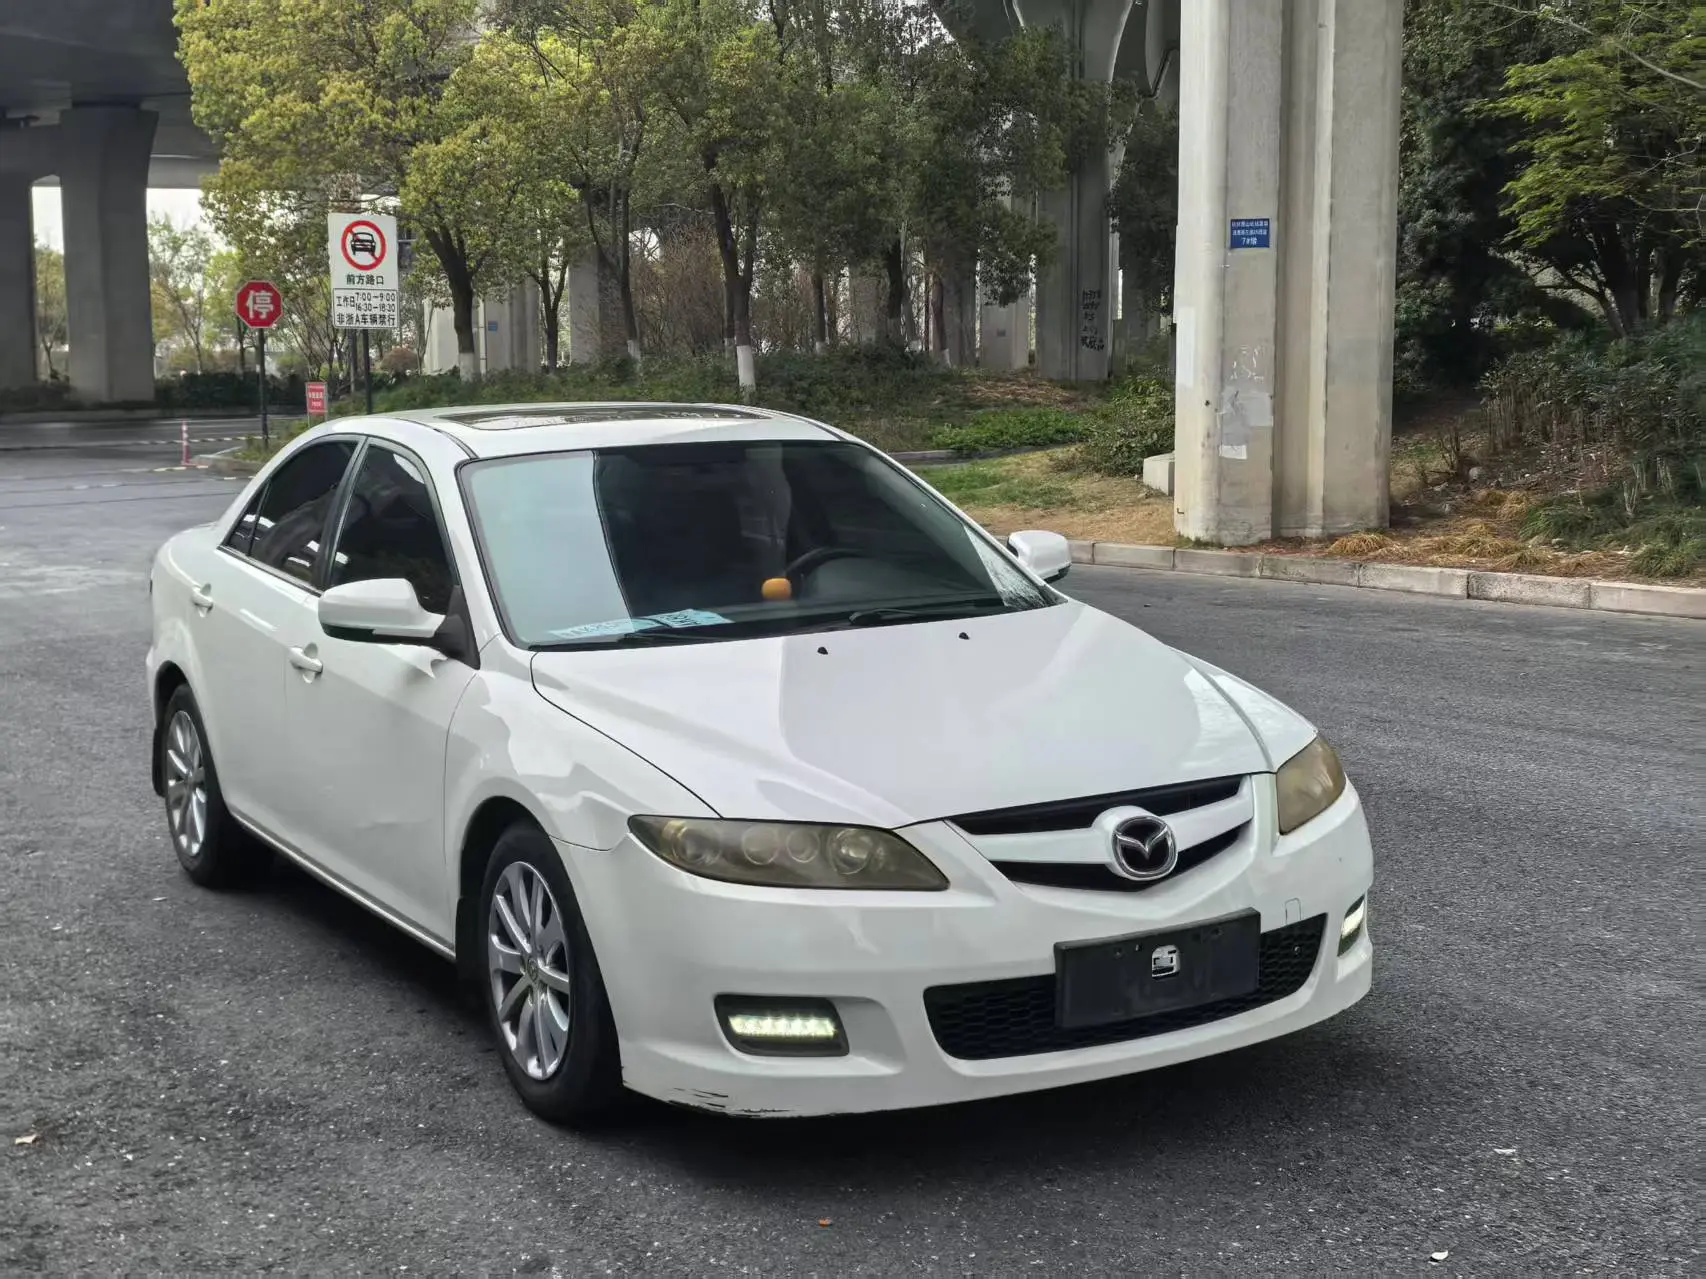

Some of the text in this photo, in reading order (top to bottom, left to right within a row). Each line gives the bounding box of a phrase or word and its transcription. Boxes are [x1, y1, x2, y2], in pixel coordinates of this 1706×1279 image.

[346, 274, 384, 285] 前方路口
[246, 290, 273, 319] 停
[336, 295, 355, 307] 工作日
[337, 313, 395, 326] 非浙A车辆禁行
